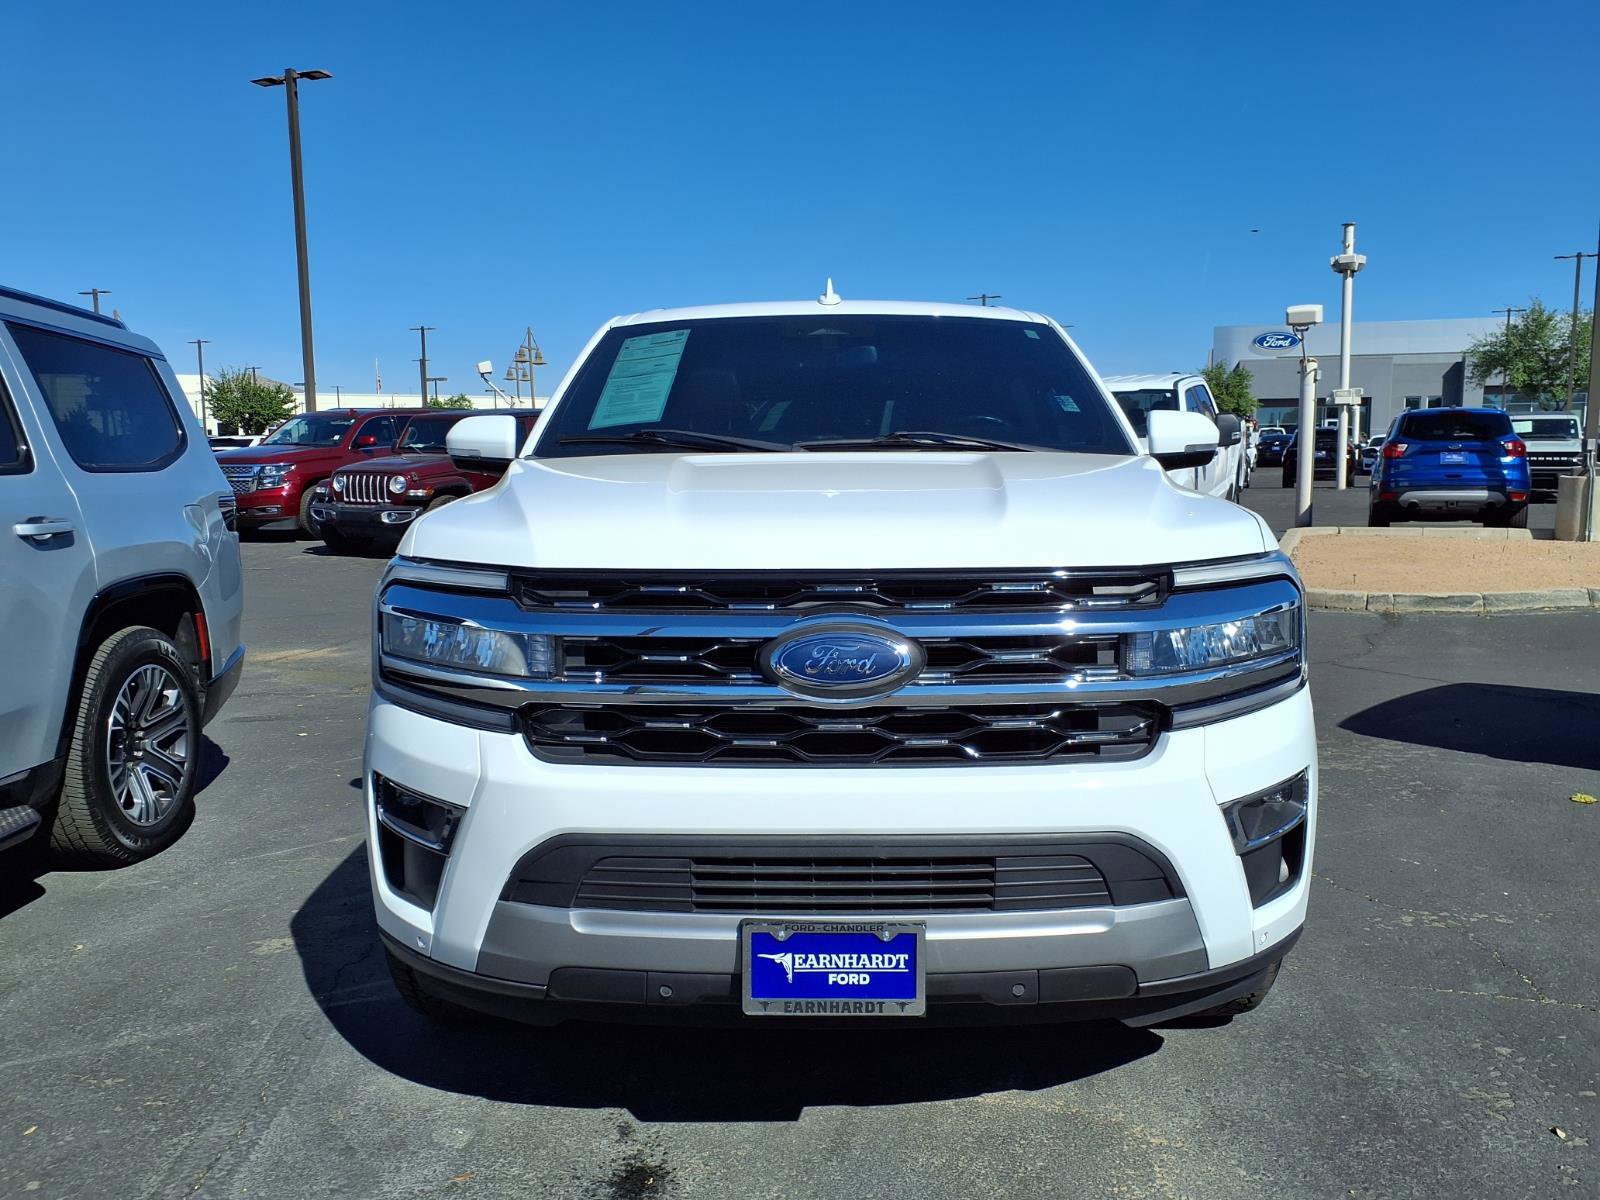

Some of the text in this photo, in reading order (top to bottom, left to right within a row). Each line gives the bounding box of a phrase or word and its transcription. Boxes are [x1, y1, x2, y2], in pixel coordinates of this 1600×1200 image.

[1263, 335, 1292, 347] Ford
[805, 644, 877, 675] Ford
[793, 953, 909, 969] EARNHARDT
[828, 973, 870, 985] FORD
[784, 1001, 886, 1013] EARNHARDT
